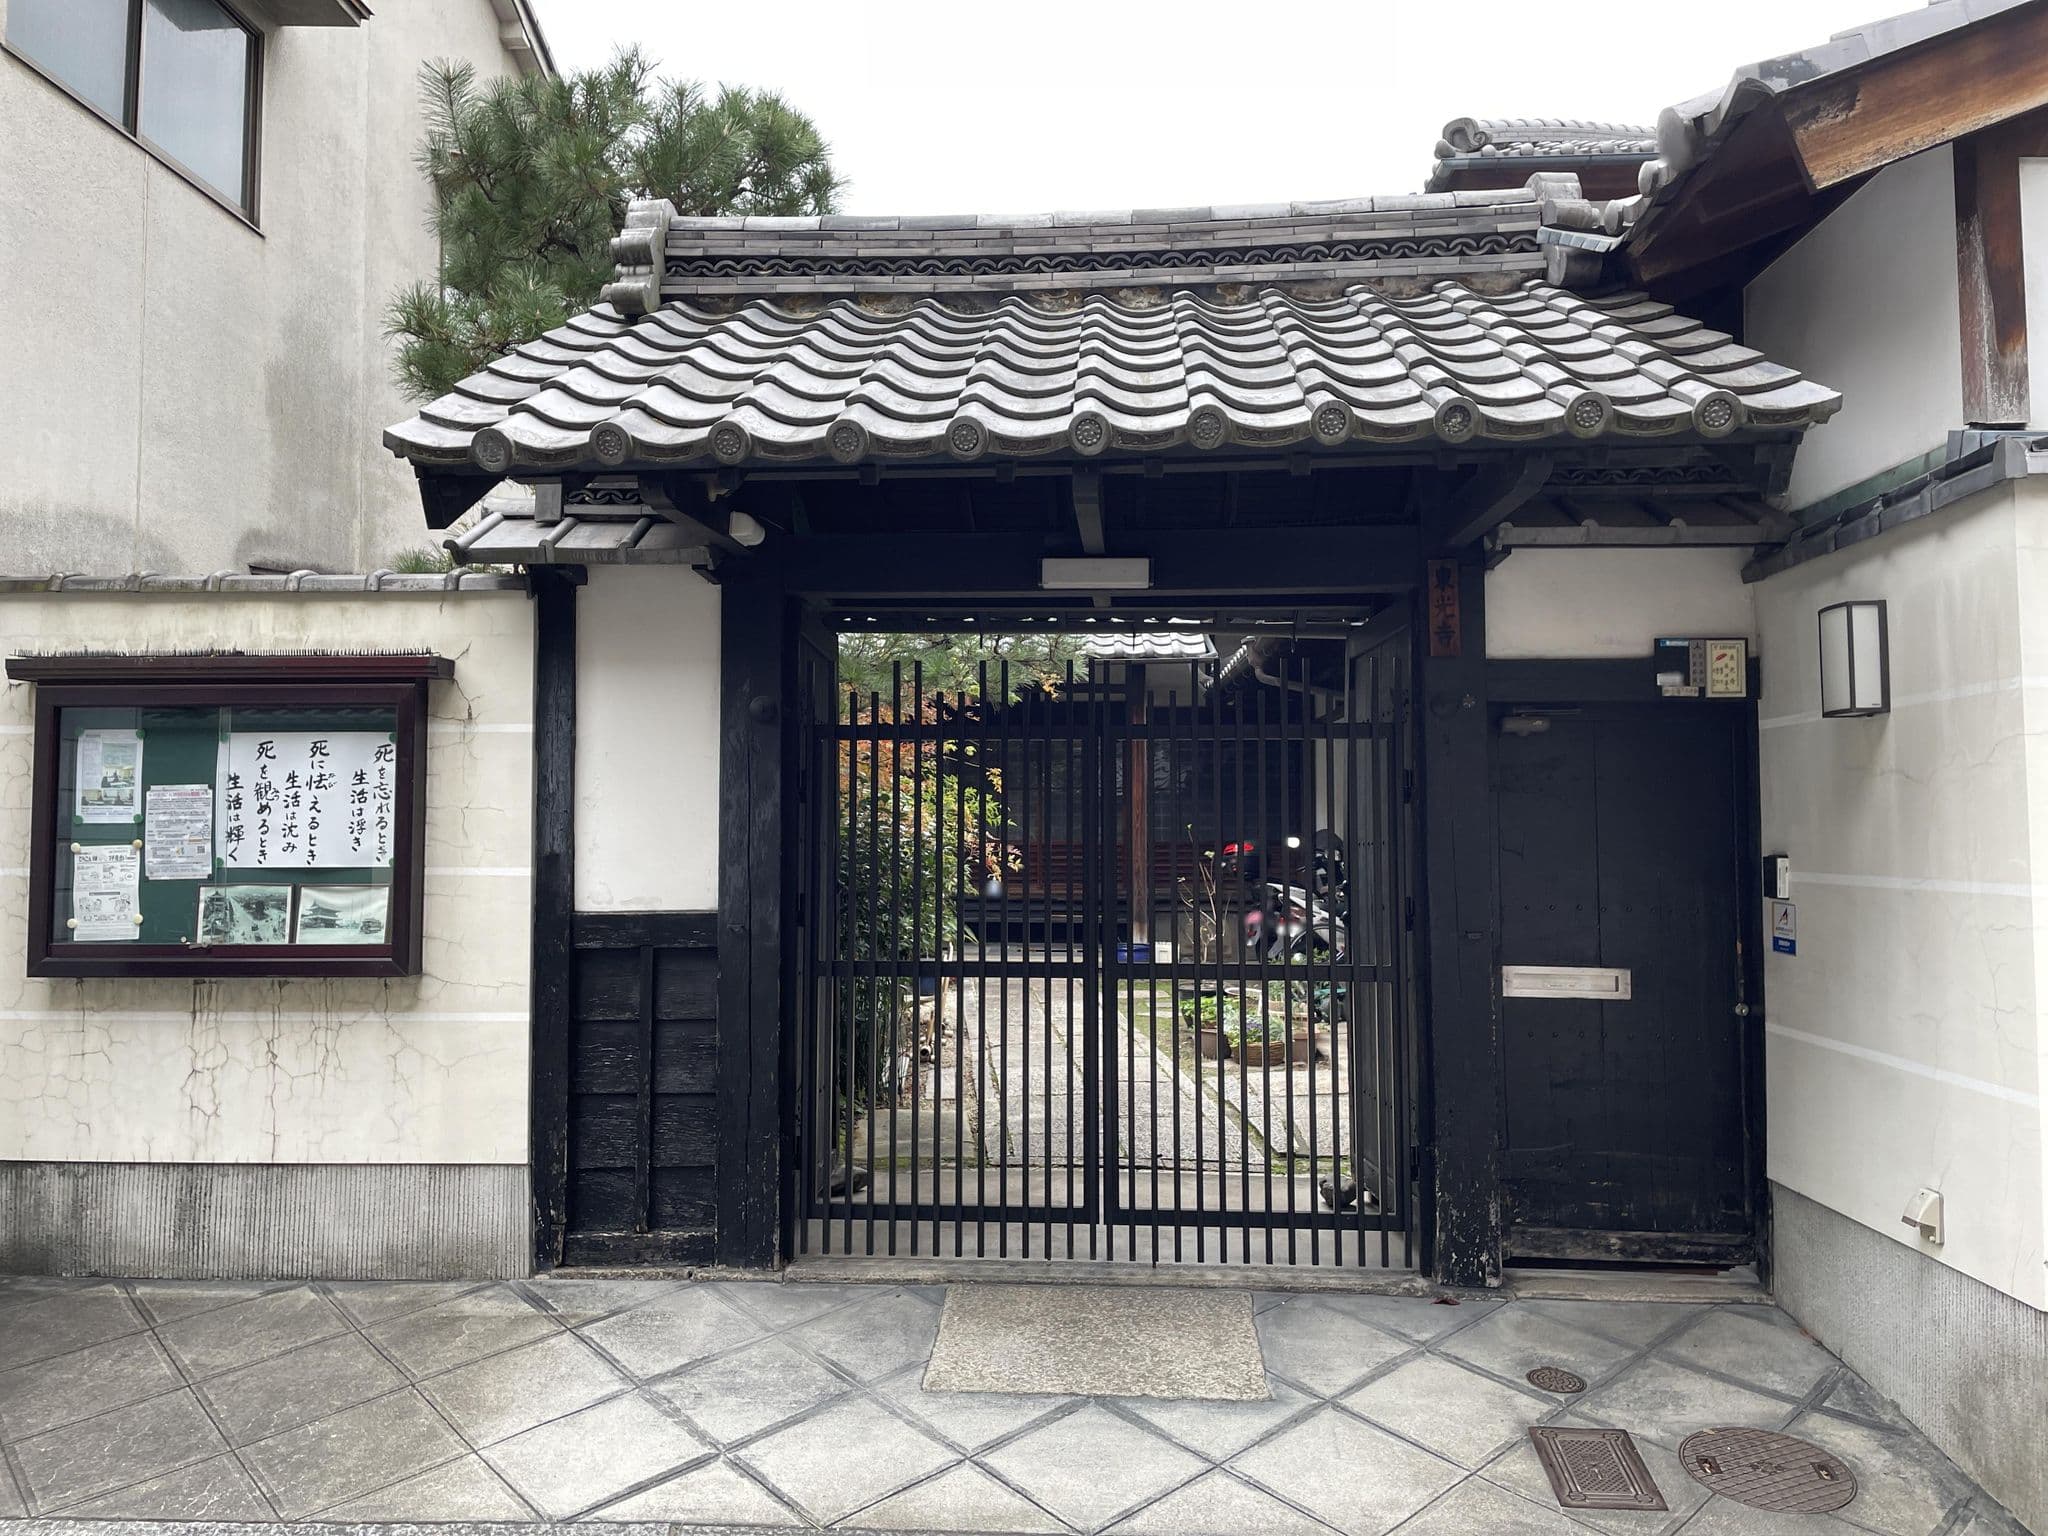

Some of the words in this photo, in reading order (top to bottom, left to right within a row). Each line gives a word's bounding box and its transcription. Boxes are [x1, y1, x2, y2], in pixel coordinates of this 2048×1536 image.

[1433, 566, 1456, 647] 東光寺
[225, 772, 245, 862] 生活は輝く
[281, 770, 302, 853] 生活は沈み
